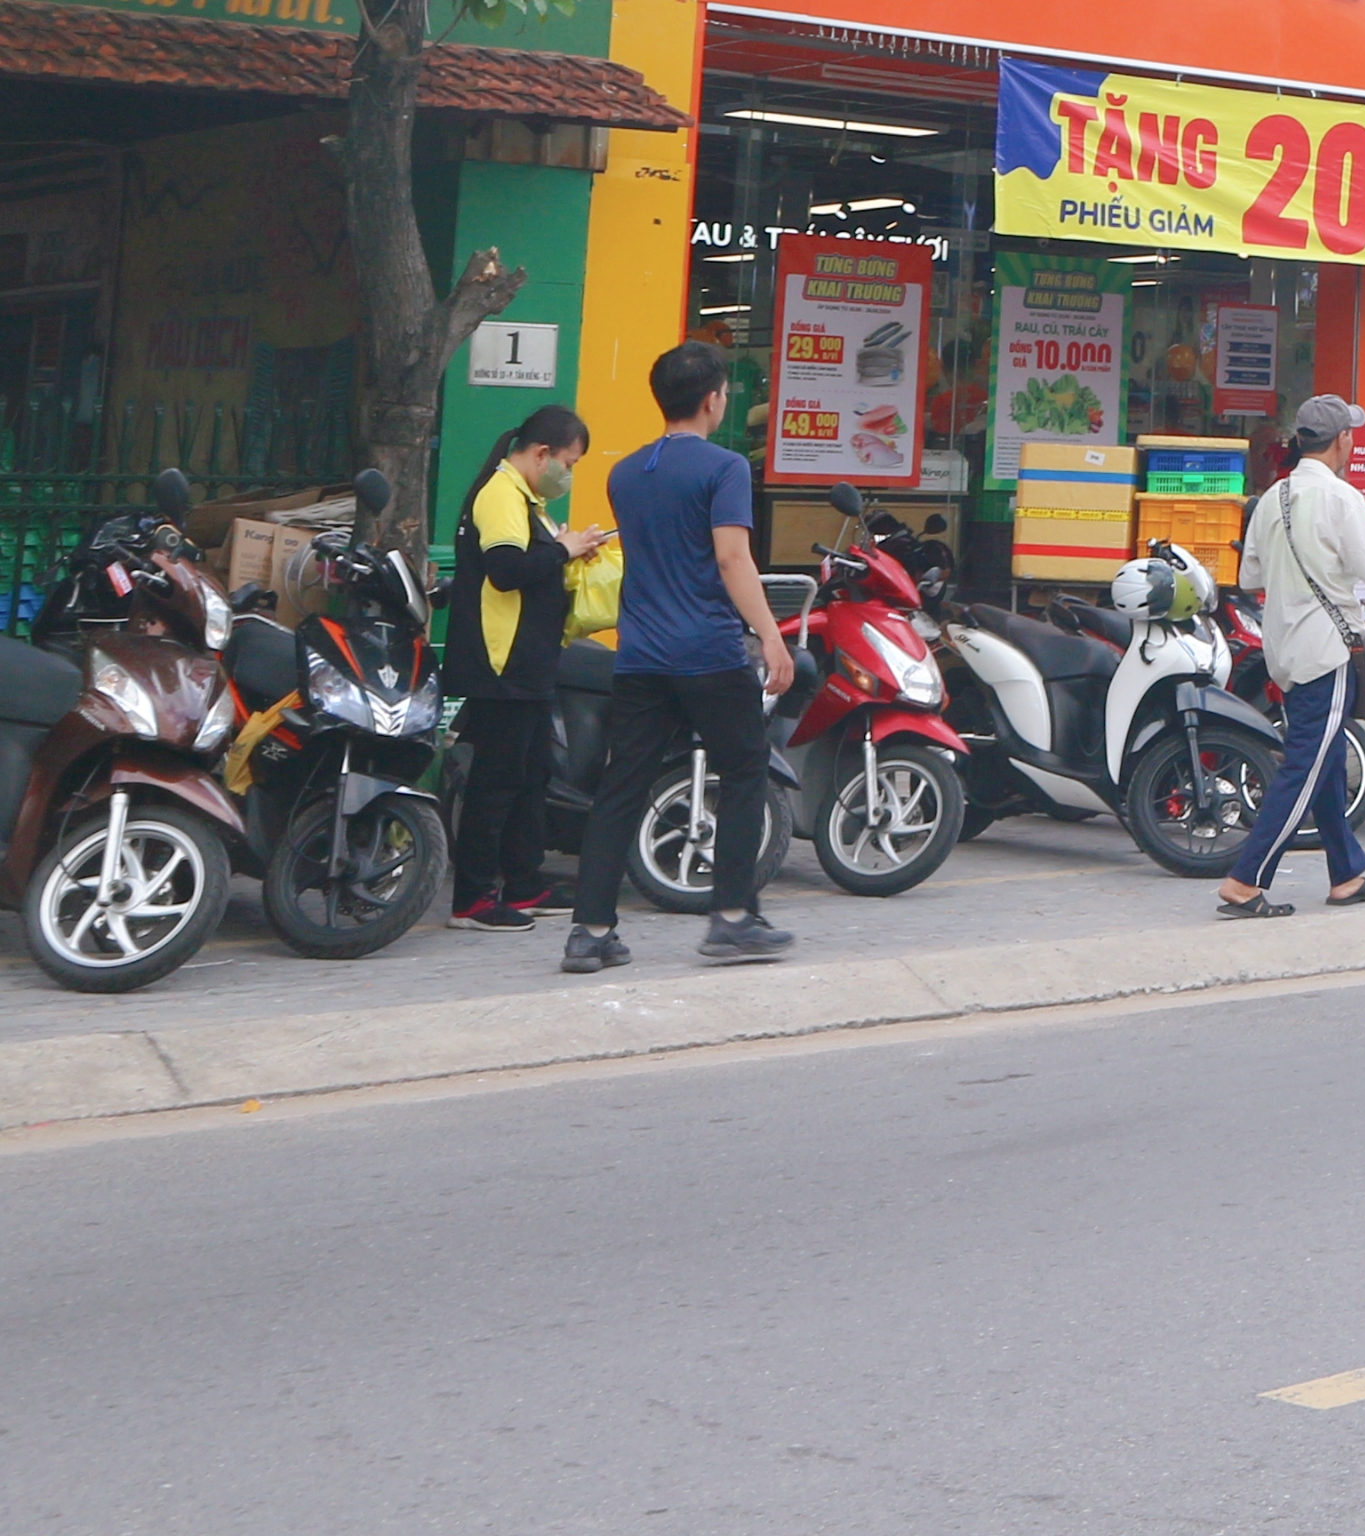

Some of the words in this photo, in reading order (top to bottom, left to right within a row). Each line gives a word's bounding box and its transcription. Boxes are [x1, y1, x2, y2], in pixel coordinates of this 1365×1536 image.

[1057, 94, 1218, 193] TẶNG
[1060, 197, 1141, 230] PHIẾU
[1149, 206, 1214, 238] GIẢM
[690, 219, 732, 246] AU
[806, 278, 842, 298] KHAI
[1027, 291, 1052, 307] KHAI
[1015, 321, 1041, 336] RAU,
[1062, 321, 1086, 336] TRÁI
[1088, 324, 1109, 338] CÂY
[505, 330, 523, 365] 1
[827, 683, 851, 703] HONDA
